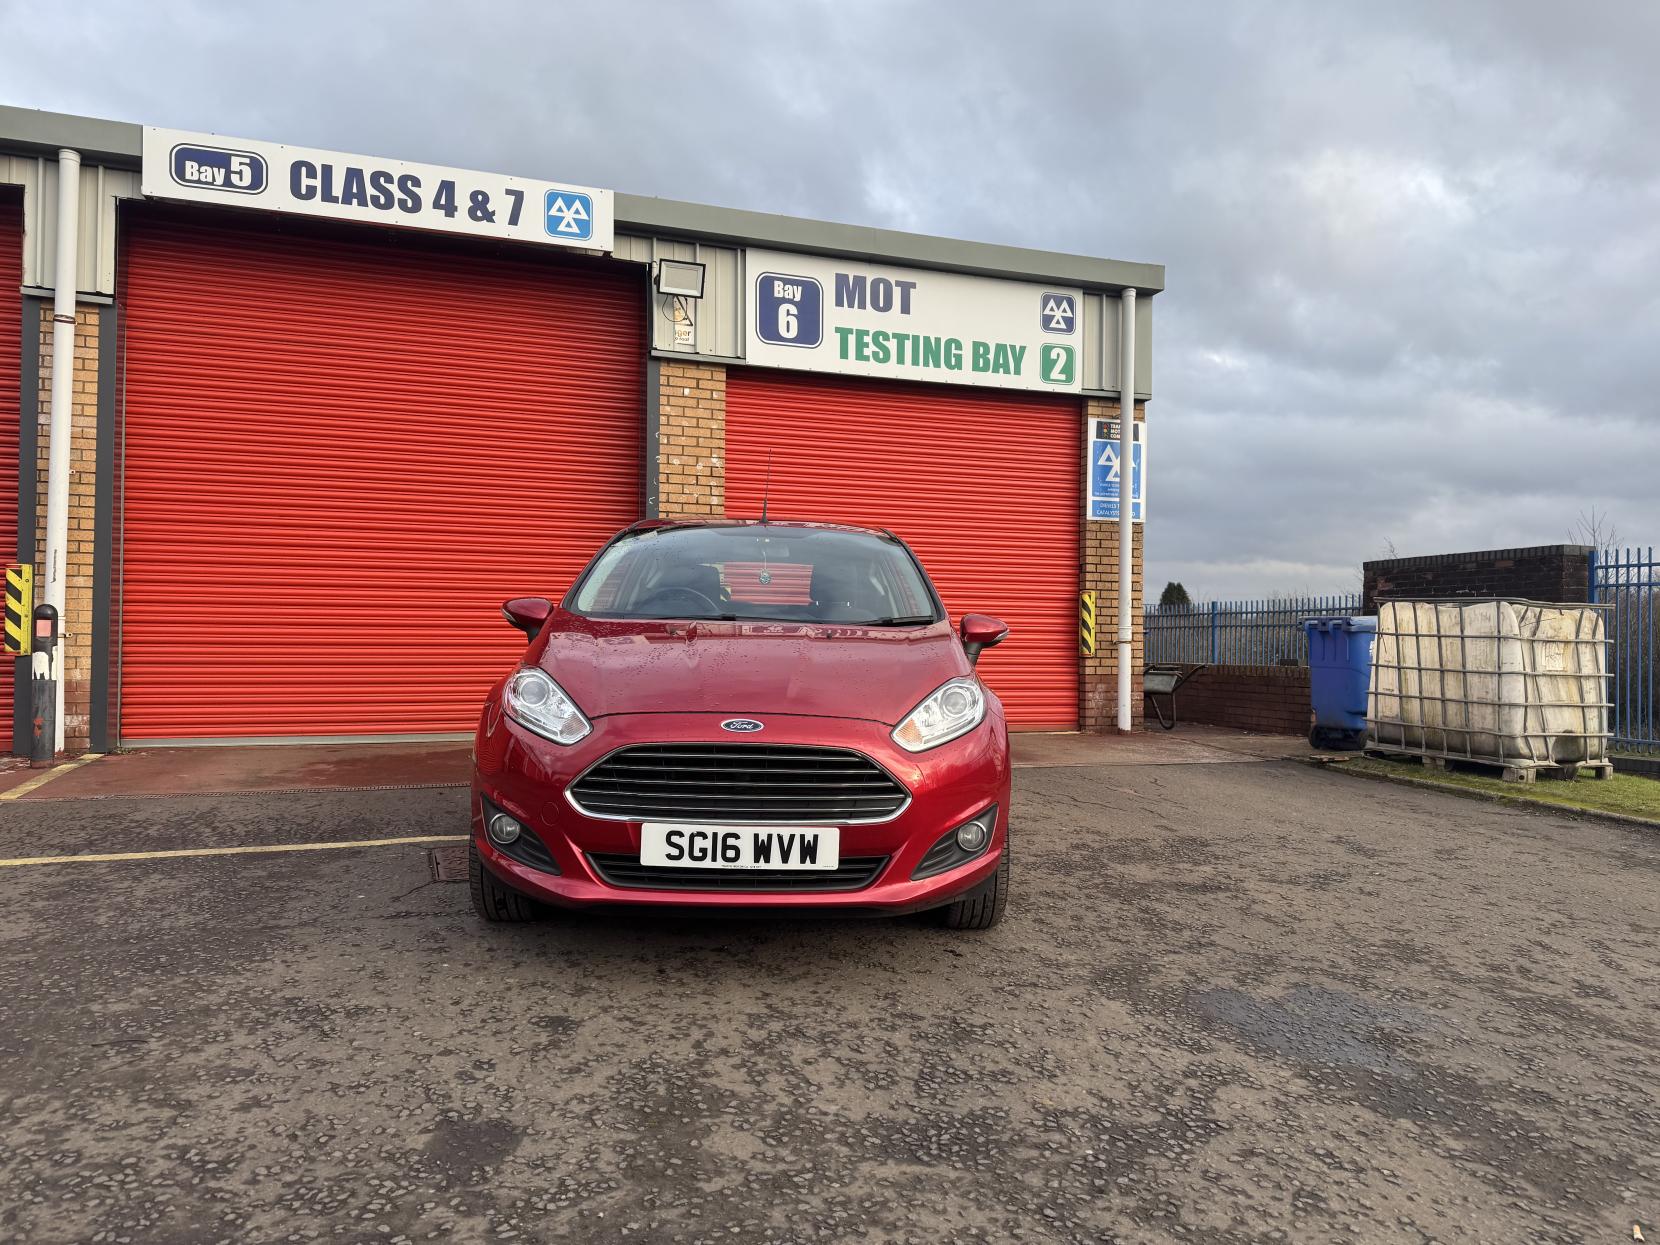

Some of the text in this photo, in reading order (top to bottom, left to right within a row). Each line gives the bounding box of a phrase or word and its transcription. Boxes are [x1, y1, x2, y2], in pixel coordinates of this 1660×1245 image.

[184, 155, 252, 187] Bay 5
[289, 159, 525, 227] CLASS 4 & 7
[773, 280, 803, 302] Bay
[834, 272, 917, 315] MOT
[778, 303, 799, 339] 6
[834, 326, 1027, 376] TESTING BAY
[1049, 347, 1067, 381] 2
[730, 721, 754, 729] Ford
[665, 829, 819, 865] SG16 WVW
